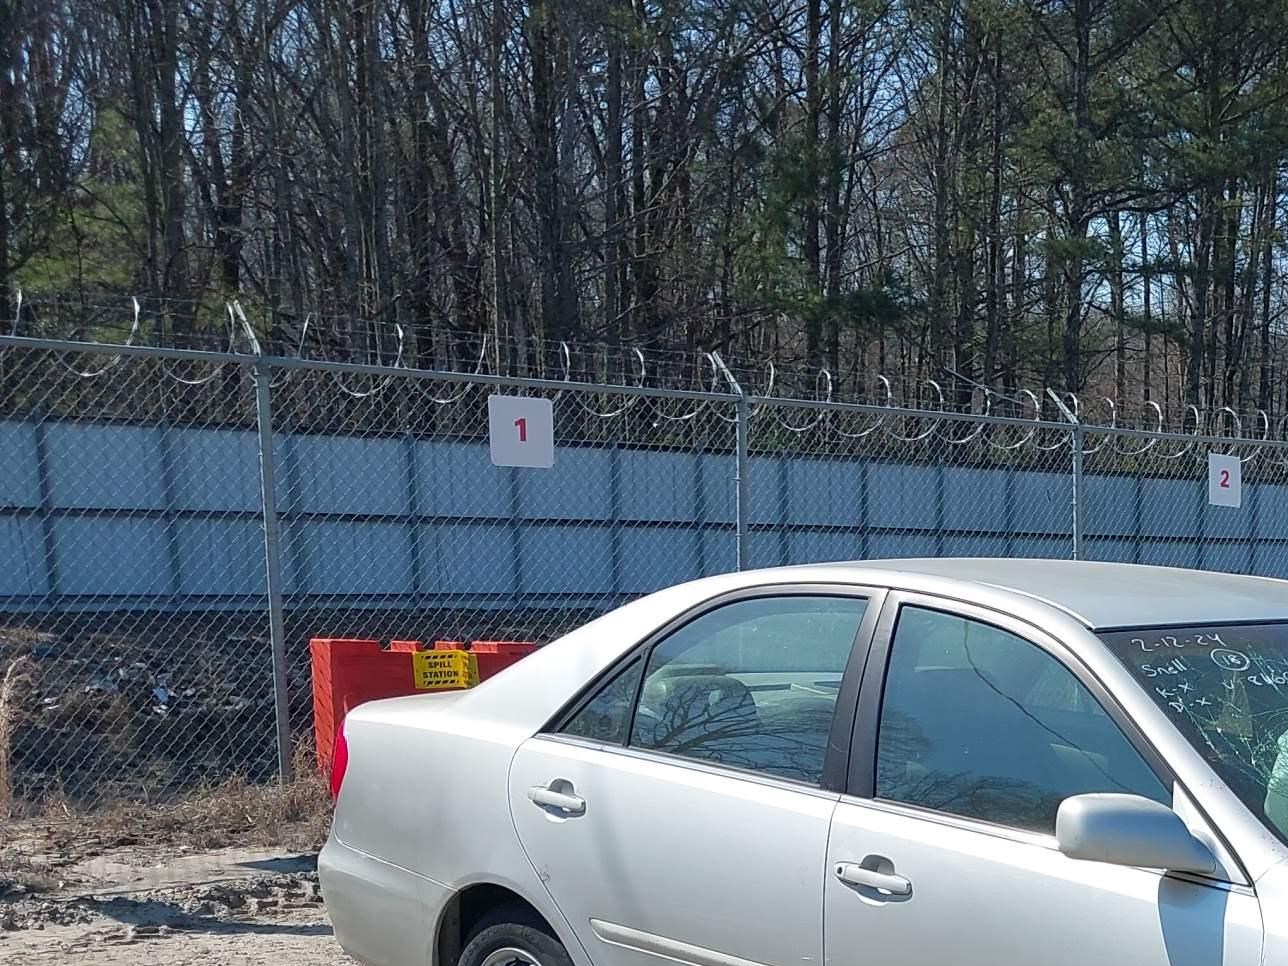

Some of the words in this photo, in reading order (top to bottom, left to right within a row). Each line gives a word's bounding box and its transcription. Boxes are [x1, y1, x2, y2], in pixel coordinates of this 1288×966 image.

[513, 417, 528, 442] 1
[1220, 470, 1230, 488] 2
[1131, 633, 1228, 652] 2-12-24
[427, 661, 453, 669] SPILL
[423, 671, 459, 679] STATION
